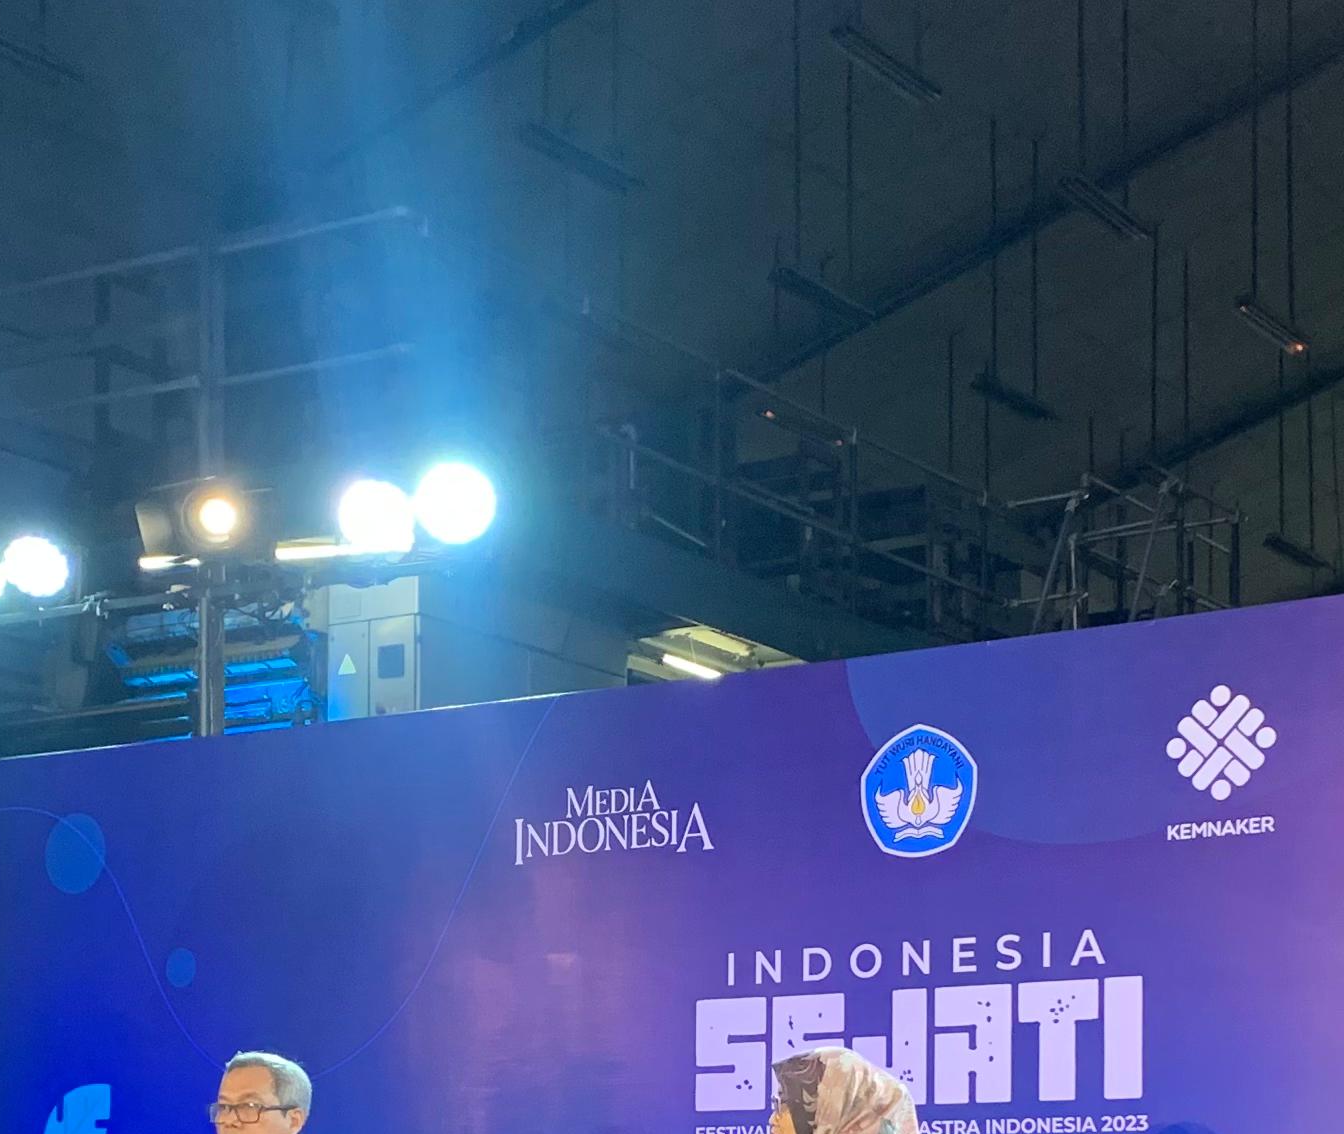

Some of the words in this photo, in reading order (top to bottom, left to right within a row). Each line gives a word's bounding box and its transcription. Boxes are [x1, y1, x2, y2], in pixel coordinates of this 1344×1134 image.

[875, 754, 891, 775] TUT
[891, 737, 915, 757] WURI
[916, 735, 965, 770] HANDAYANI
[565, 779, 661, 819] MEDIA
[514, 802, 715, 866] INDONESIA
[1167, 816, 1275, 840] KEMNAKER
[727, 929, 1106, 986] INDONESIA
[985, 1116, 1097, 1134] INDONESIA
[1101, 1115, 1149, 1132] 2023
